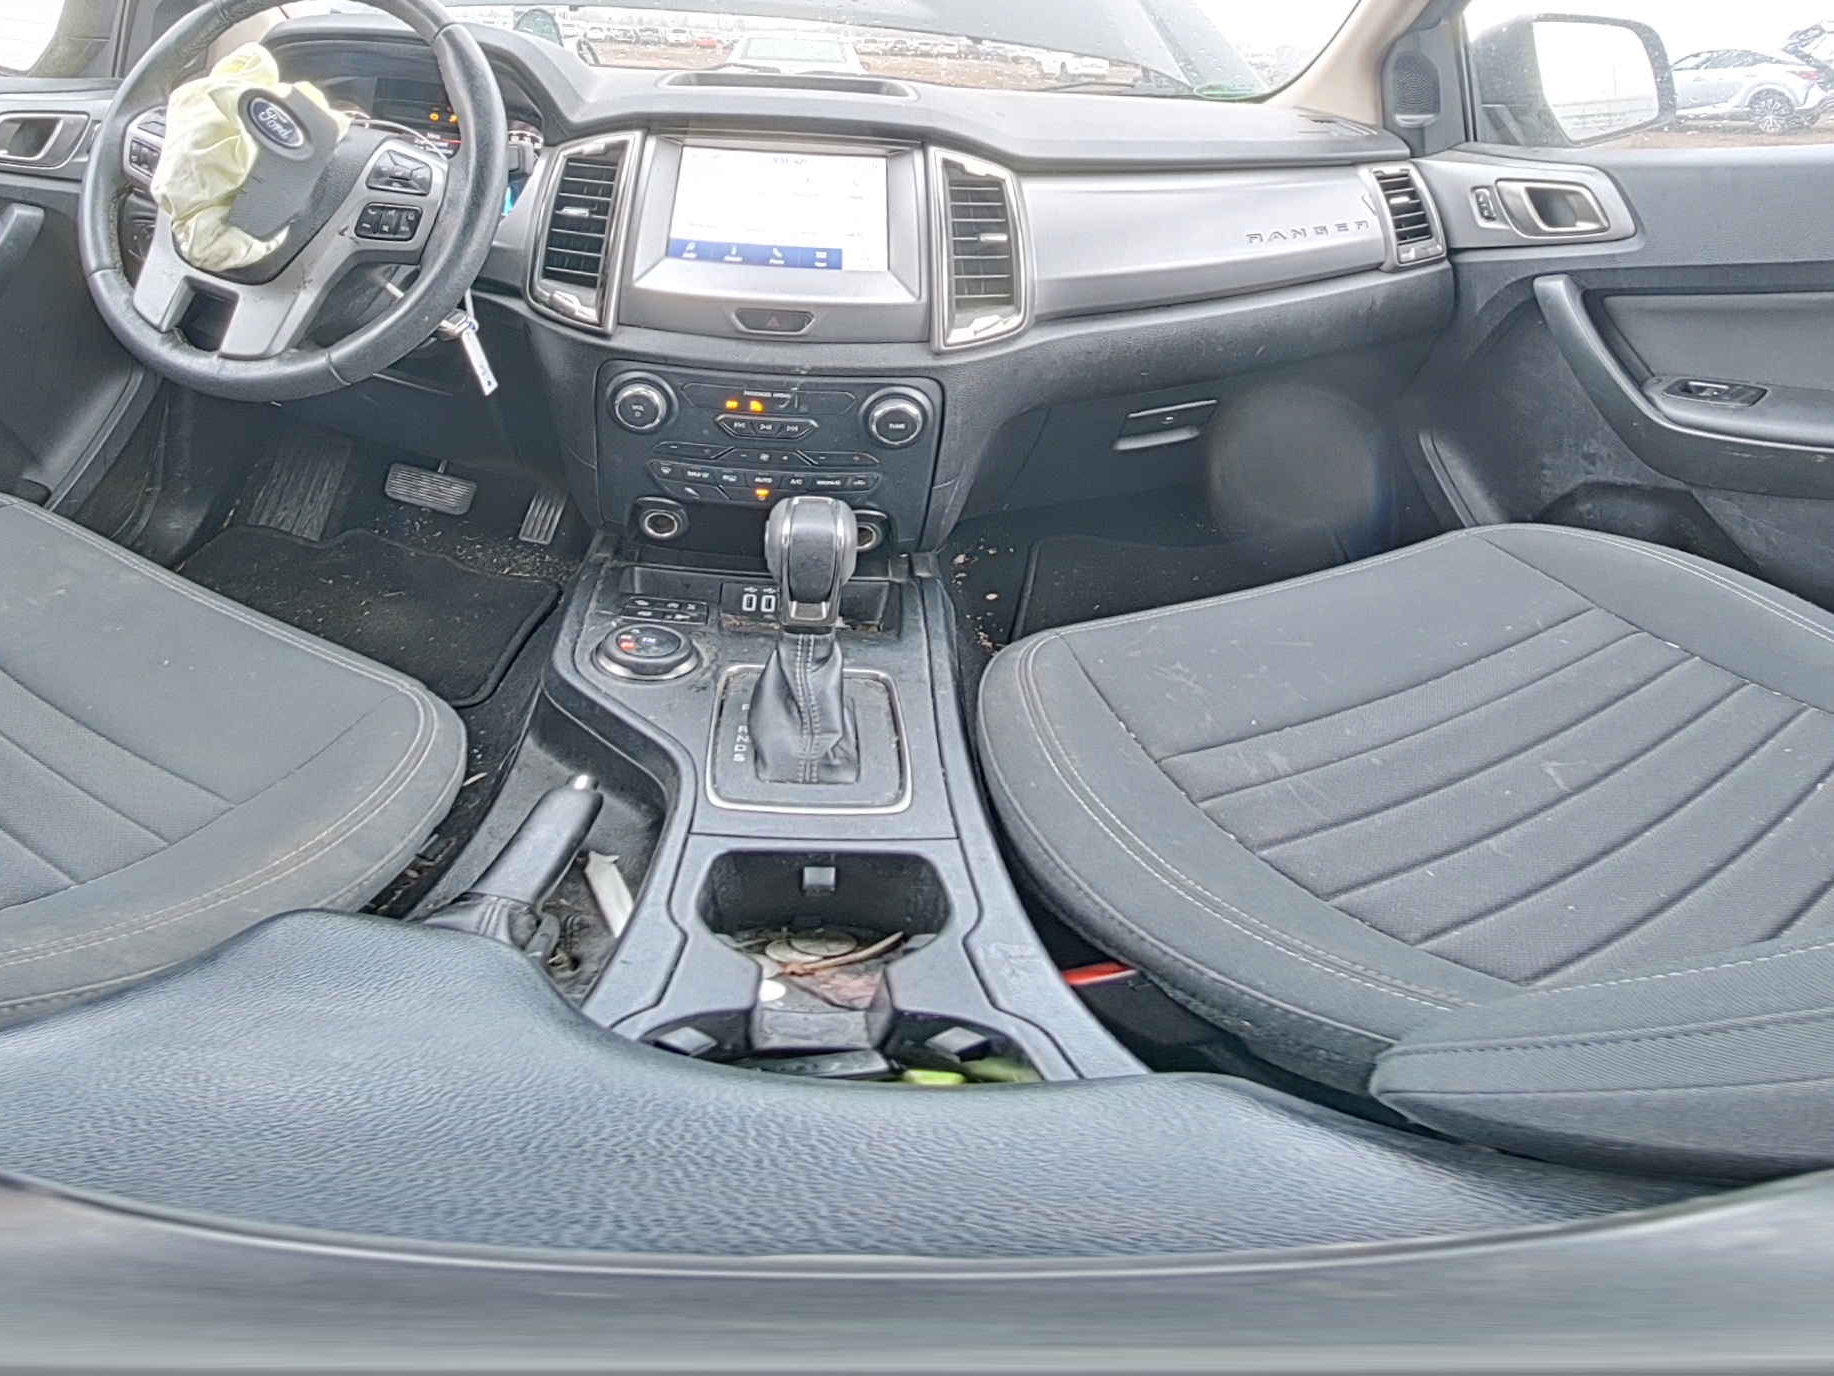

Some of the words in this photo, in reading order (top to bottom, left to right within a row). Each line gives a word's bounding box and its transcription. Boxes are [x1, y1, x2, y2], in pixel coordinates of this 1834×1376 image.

[258, 107, 293, 140] Ford
[1246, 219, 1370, 244] RANGER
[736, 734, 750, 743] N
[733, 744, 747, 752] D
[732, 753, 745, 762] S
